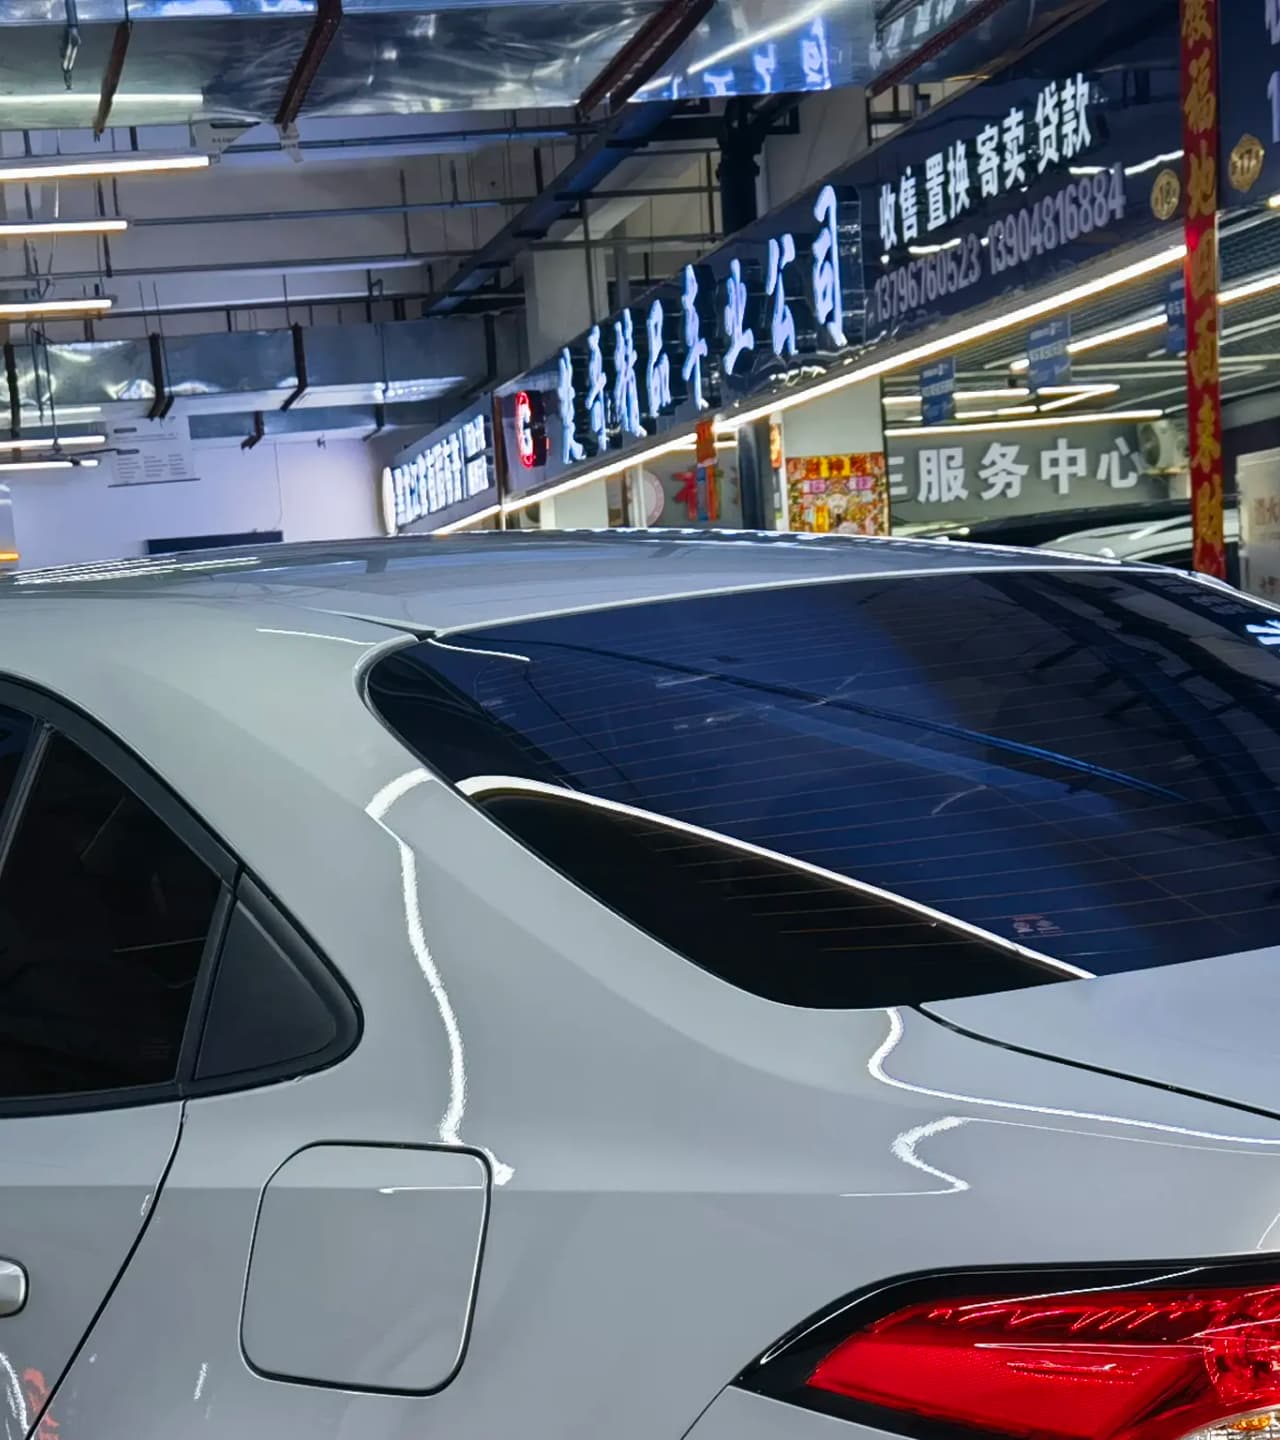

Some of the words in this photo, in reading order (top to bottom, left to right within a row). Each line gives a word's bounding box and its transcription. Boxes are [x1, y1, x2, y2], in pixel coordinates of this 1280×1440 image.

[879, 166, 918, 251] 收售
[925, 139, 971, 232] 置换
[976, 107, 1027, 200] 寄卖
[1034, 72, 1092, 174] 贷款
